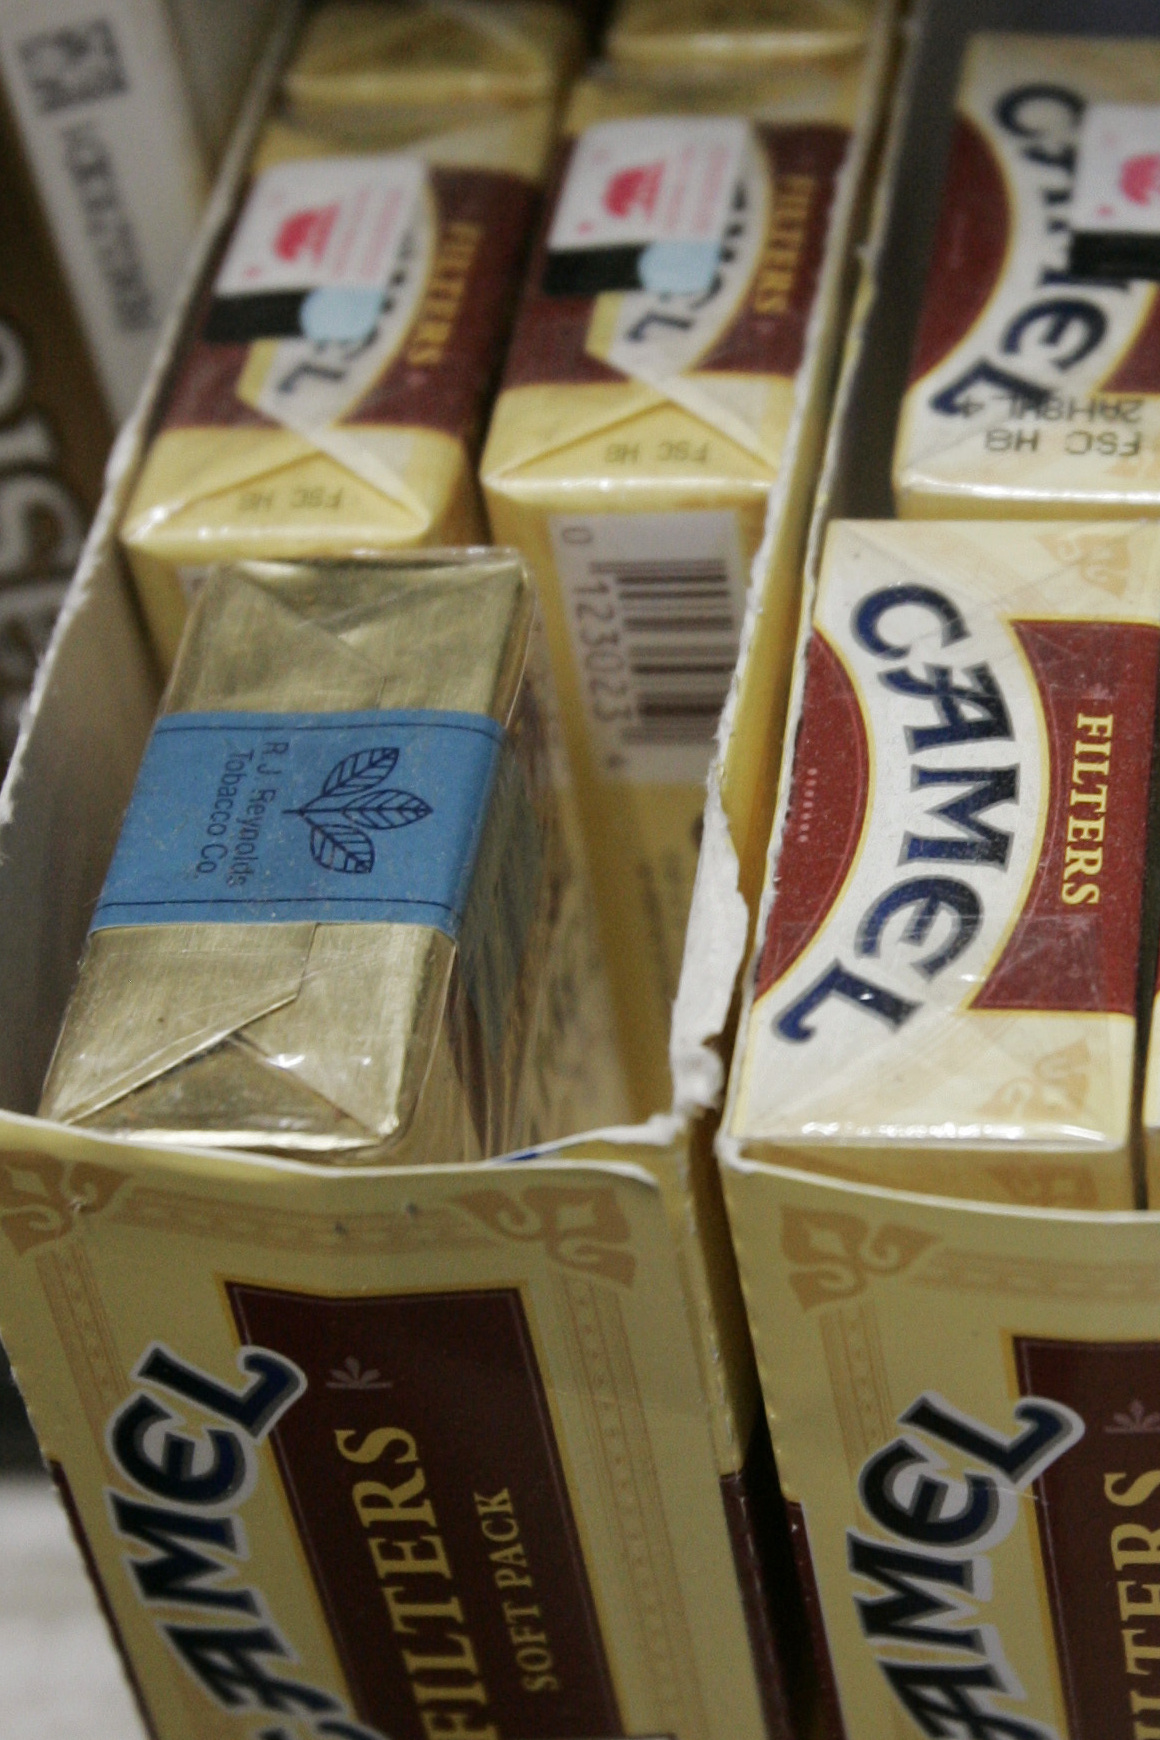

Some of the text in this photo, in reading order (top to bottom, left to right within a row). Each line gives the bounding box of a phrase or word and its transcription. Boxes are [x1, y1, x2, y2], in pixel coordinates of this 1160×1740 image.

[1064, 430, 1142, 457] FSC
[206, 749, 255, 836] Tobacco
[226, 788, 277, 887] Reynolds
[771, 581, 1021, 1044] CAMEL
[1060, 713, 1114, 907] FILTERS
[108, 1342, 390, 1740] AMEL
[473, 1486, 561, 1693] SOFT PACK
[847, 1391, 1085, 1740] AMEL
